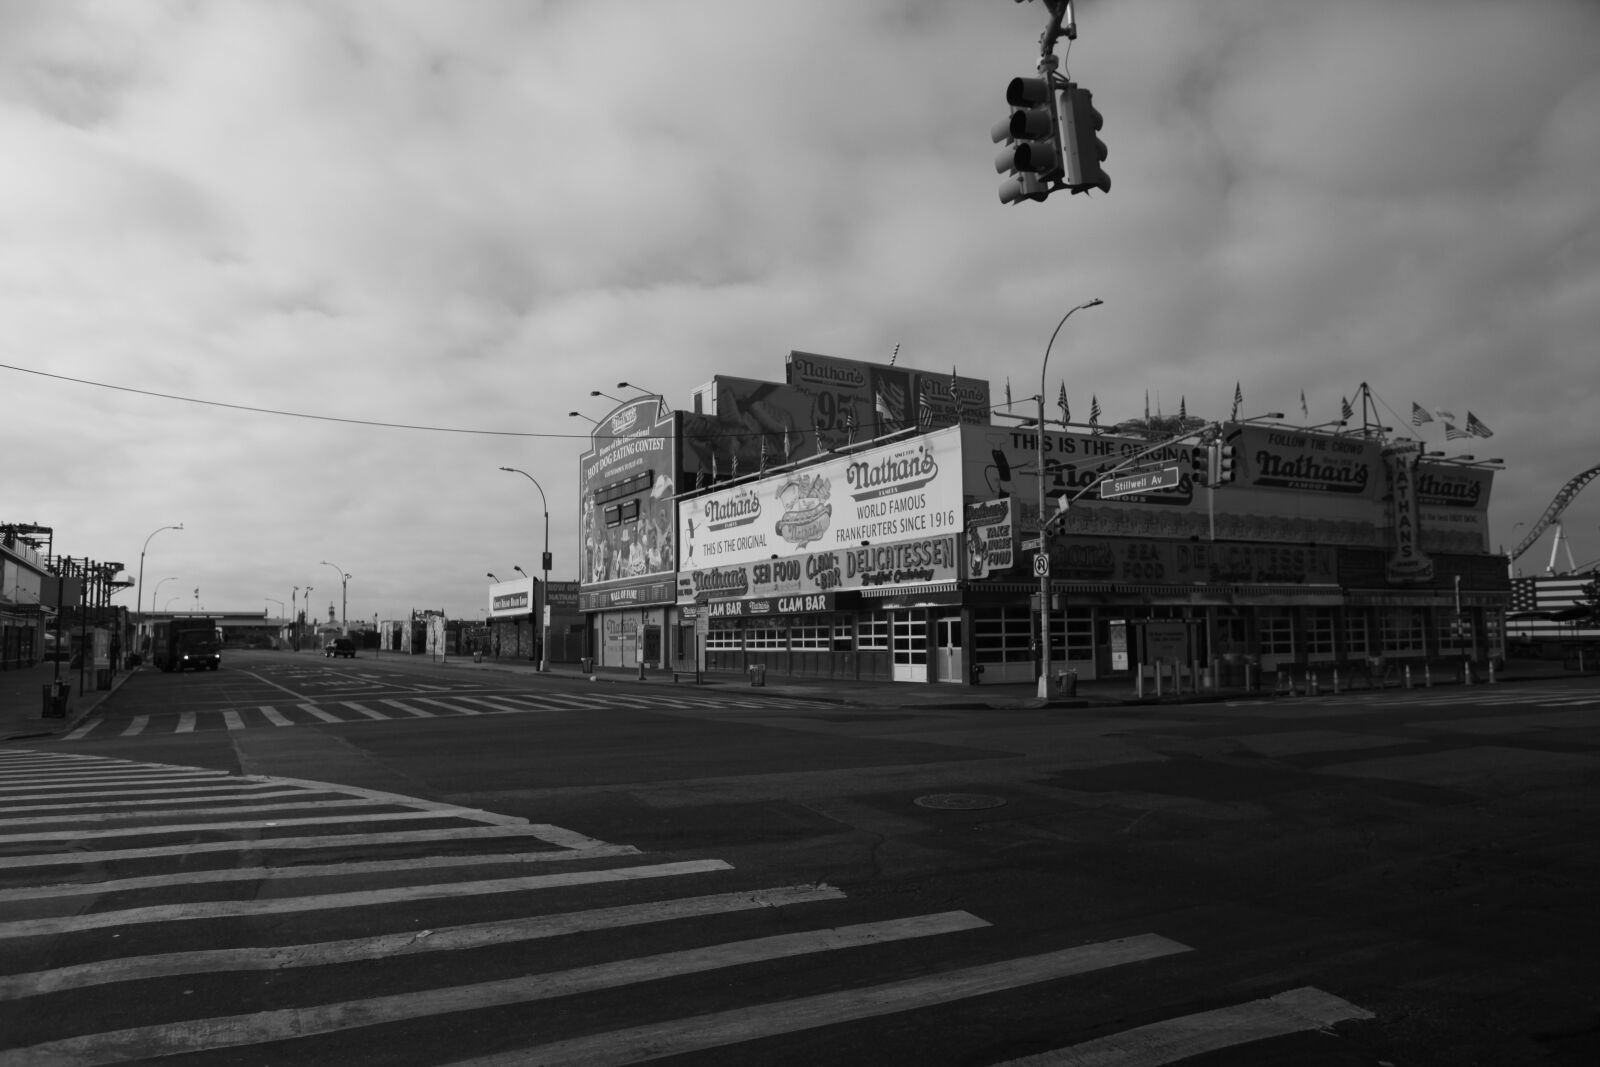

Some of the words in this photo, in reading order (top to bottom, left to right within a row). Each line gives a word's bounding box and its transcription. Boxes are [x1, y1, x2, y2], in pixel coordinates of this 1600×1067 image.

[795, 359, 864, 384] Nathan's
[1009, 432, 1053, 453] THIS
[1060, 437, 1076, 454] IS
[1080, 439, 1115, 457] THE
[1268, 433, 1305, 449] FOLLOW
[1311, 438, 1327, 450] THE
[587, 462, 600, 480] HOT
[599, 453, 613, 471] DOG
[613, 442, 635, 463] EATING
[635, 437, 665, 453] CONTEST
[846, 446, 935, 490] Nathan's
[1256, 450, 1368, 483] Nathan's
[1114, 477, 1146, 492] Stillwell
[1151, 475, 1162, 486] Av
[1418, 473, 1480, 498] than's
[705, 490, 760, 522] Nathan's
[856, 503, 887, 521] WORLD
[889, 494, 926, 514] FAMOUS
[1396, 456, 1412, 557] NATHANS
[836, 519, 898, 543] FRANKFURTERS
[900, 514, 927, 534] SINCE
[930, 510, 955, 529] 1916
[986, 525, 1010, 539] TAKE
[703, 544, 716, 557] THIS
[717, 541, 723, 554] IS
[724, 538, 736, 553] THE
[737, 533, 768, 552] ORIGINAL
[846, 537, 955, 579] DELICATESSEN
[692, 566, 748, 591] Nathan's
[753, 564, 771, 585] SEA
[774, 559, 801, 582] FOOD
[820, 567, 842, 590] BAR
[610, 590, 621, 601] WALL
[621, 590, 628, 600] OF
[628, 589, 638, 600] FAME
[778, 597, 803, 613] CLAM
[805, 594, 826, 611] BAR
[708, 602, 725, 617] LAM
[726, 601, 743, 616] BAR
